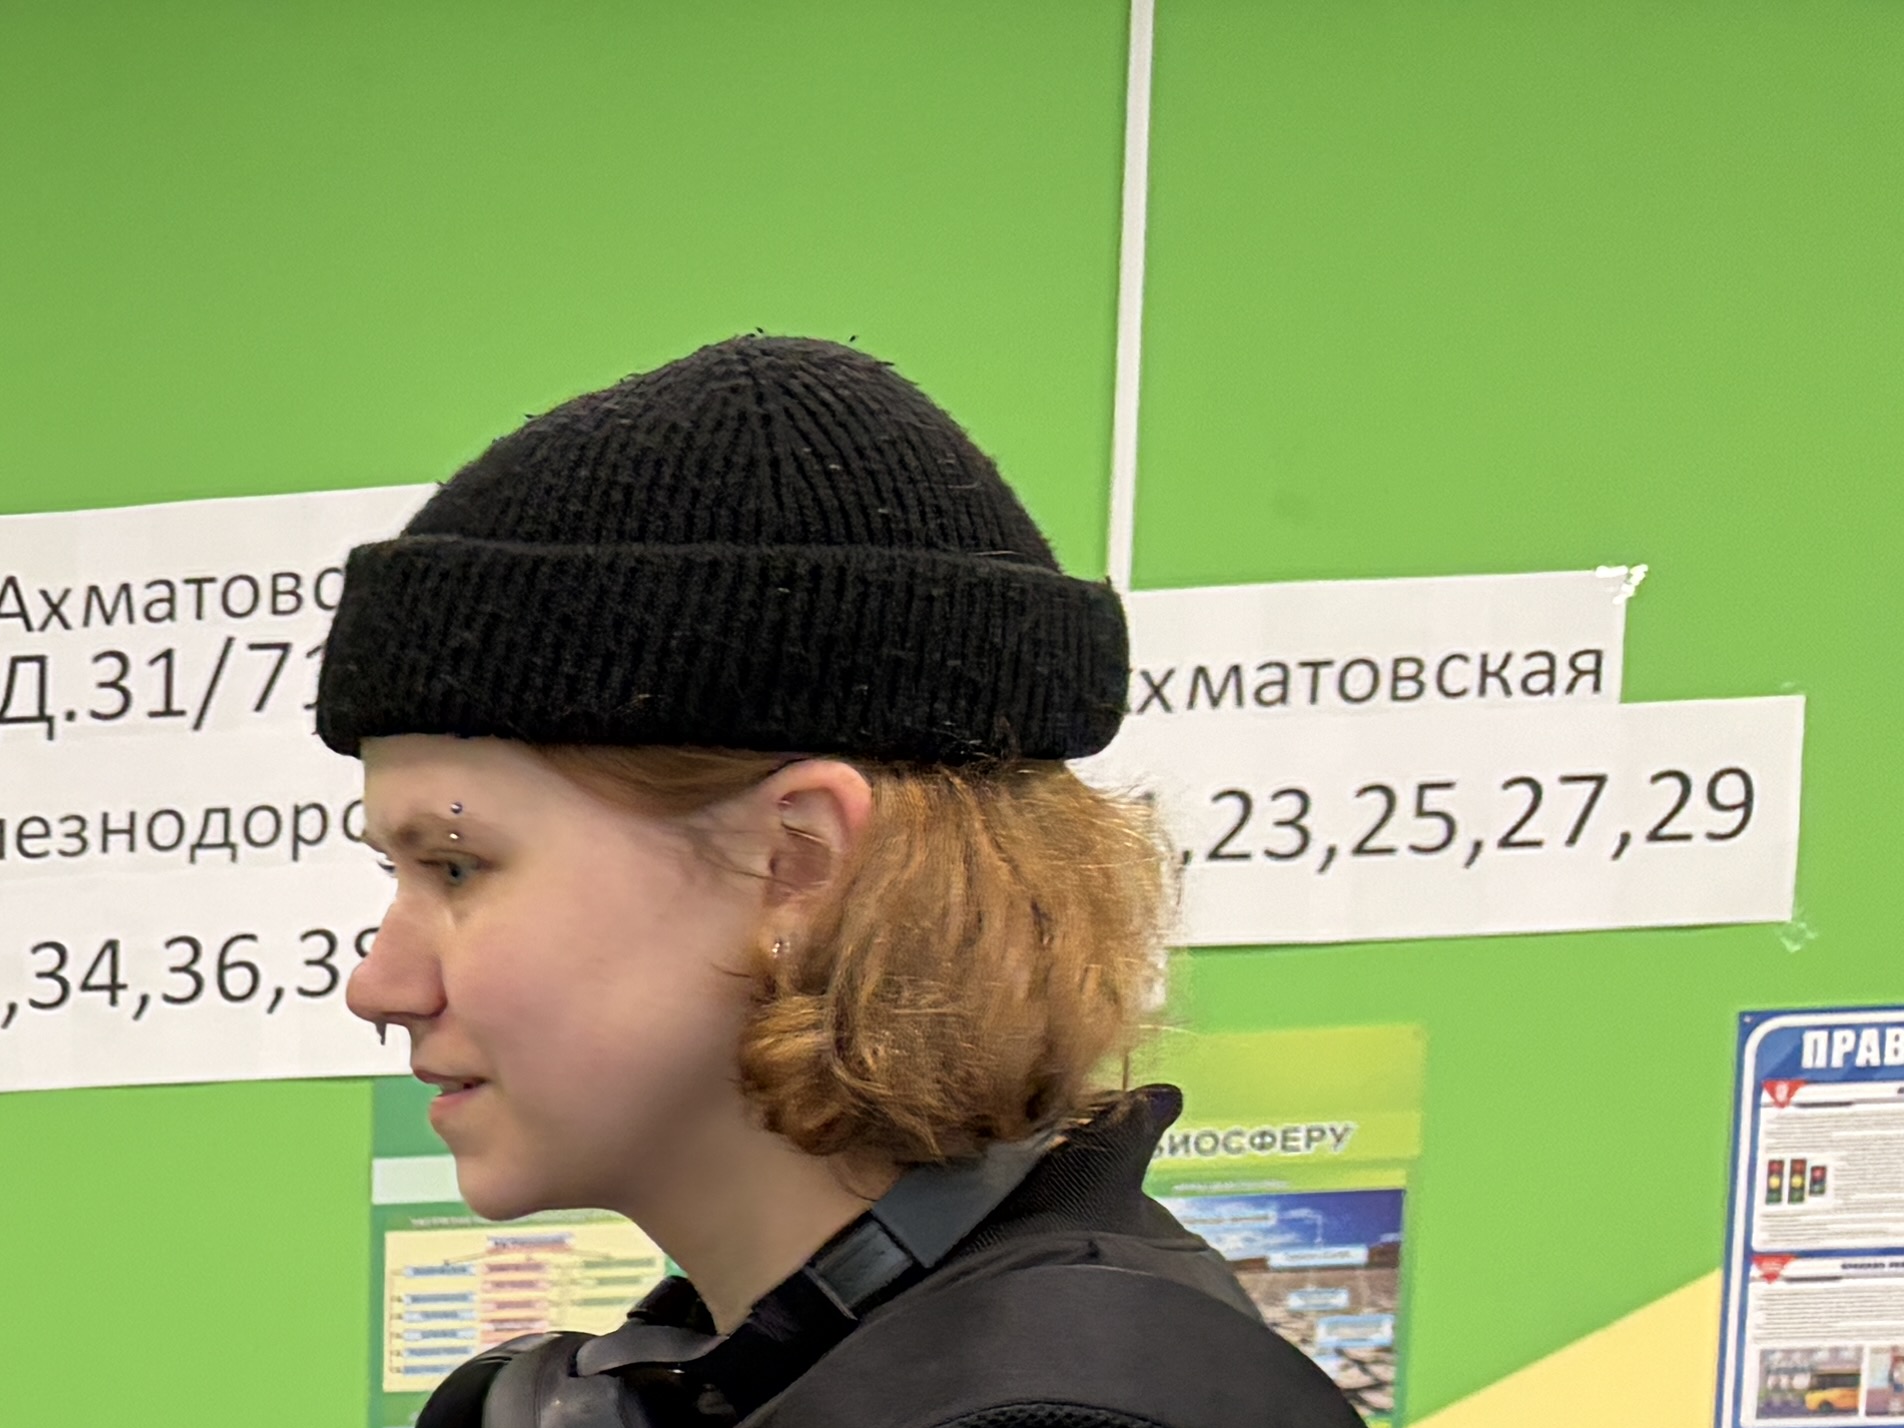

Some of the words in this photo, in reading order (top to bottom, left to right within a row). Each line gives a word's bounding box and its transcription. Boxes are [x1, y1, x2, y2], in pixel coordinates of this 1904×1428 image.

[1129, 646, 1605, 716] хматовская
[1138, 766, 1758, 874] ,23,25,27,29
[1801, 1027, 1904, 1069] ПРАВ
